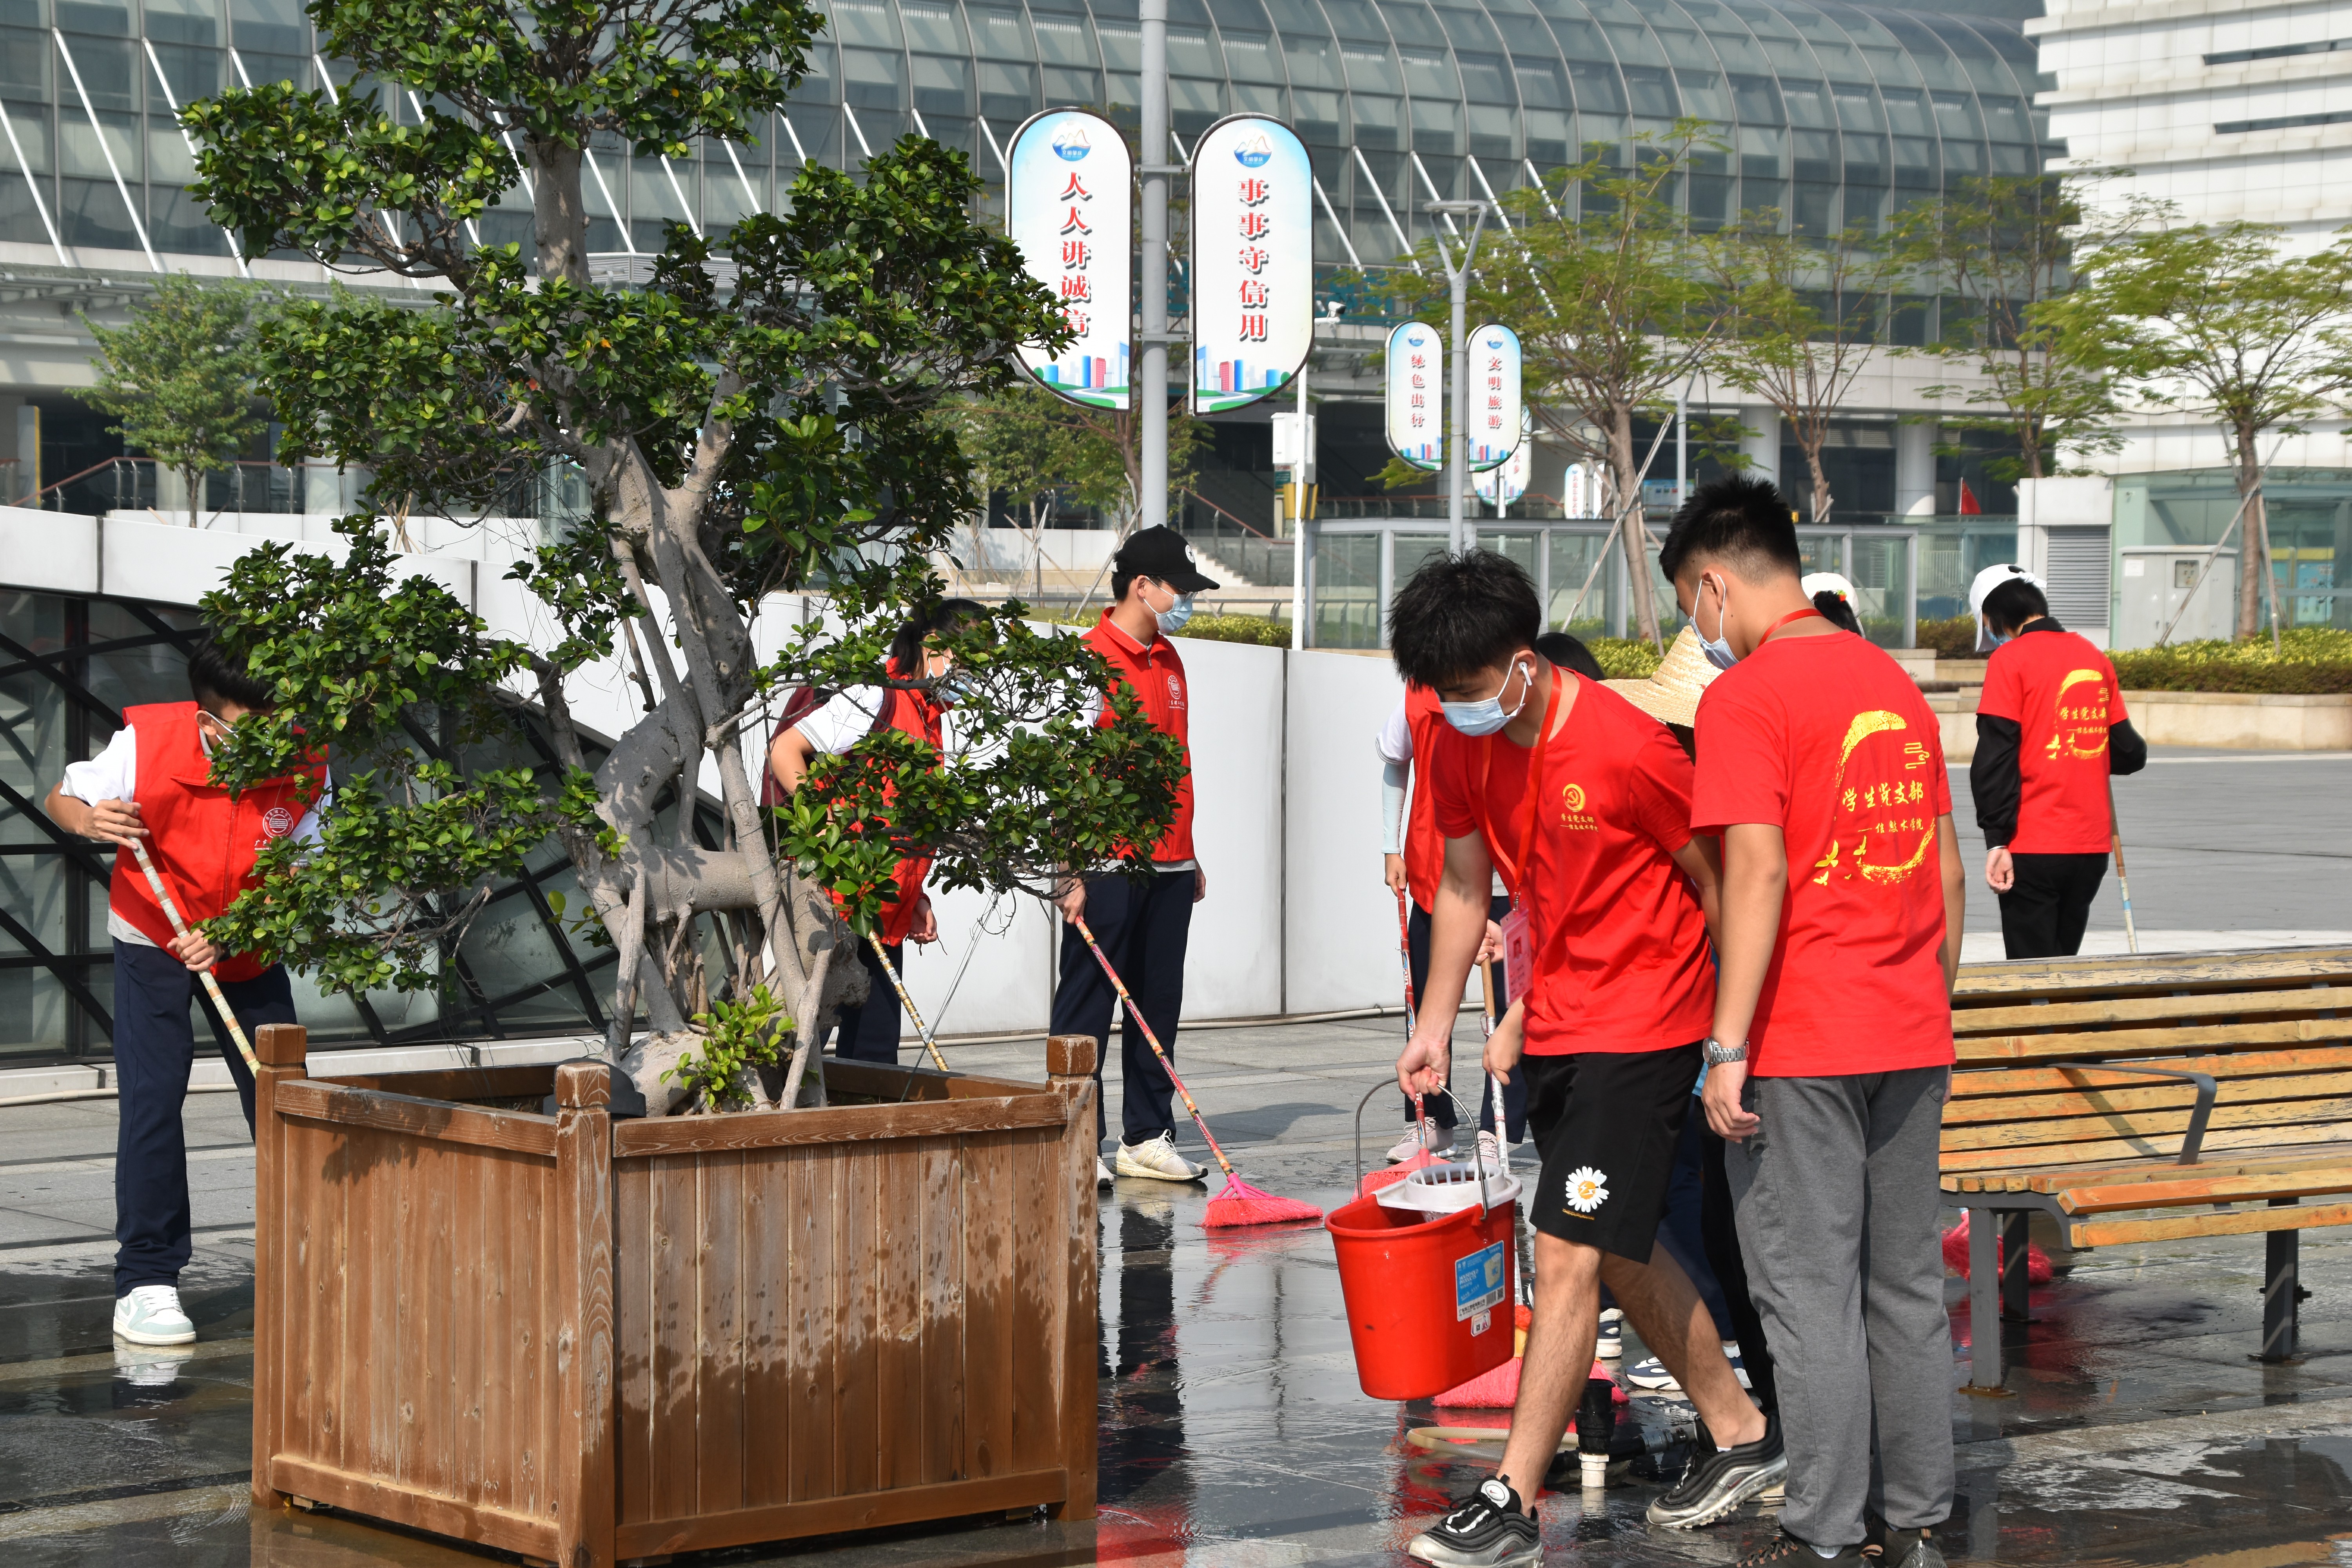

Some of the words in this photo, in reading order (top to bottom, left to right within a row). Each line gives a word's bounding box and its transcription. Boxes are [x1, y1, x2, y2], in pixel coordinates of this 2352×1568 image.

[1060, 172, 1091, 336] 人人讲诚信
[1238, 178, 1268, 340] 事事守信用
[1411, 354, 1425, 426] 绿色出行
[1488, 356, 1502, 428] 文明旅游
[1842, 780, 1924, 812] 学生党支部
